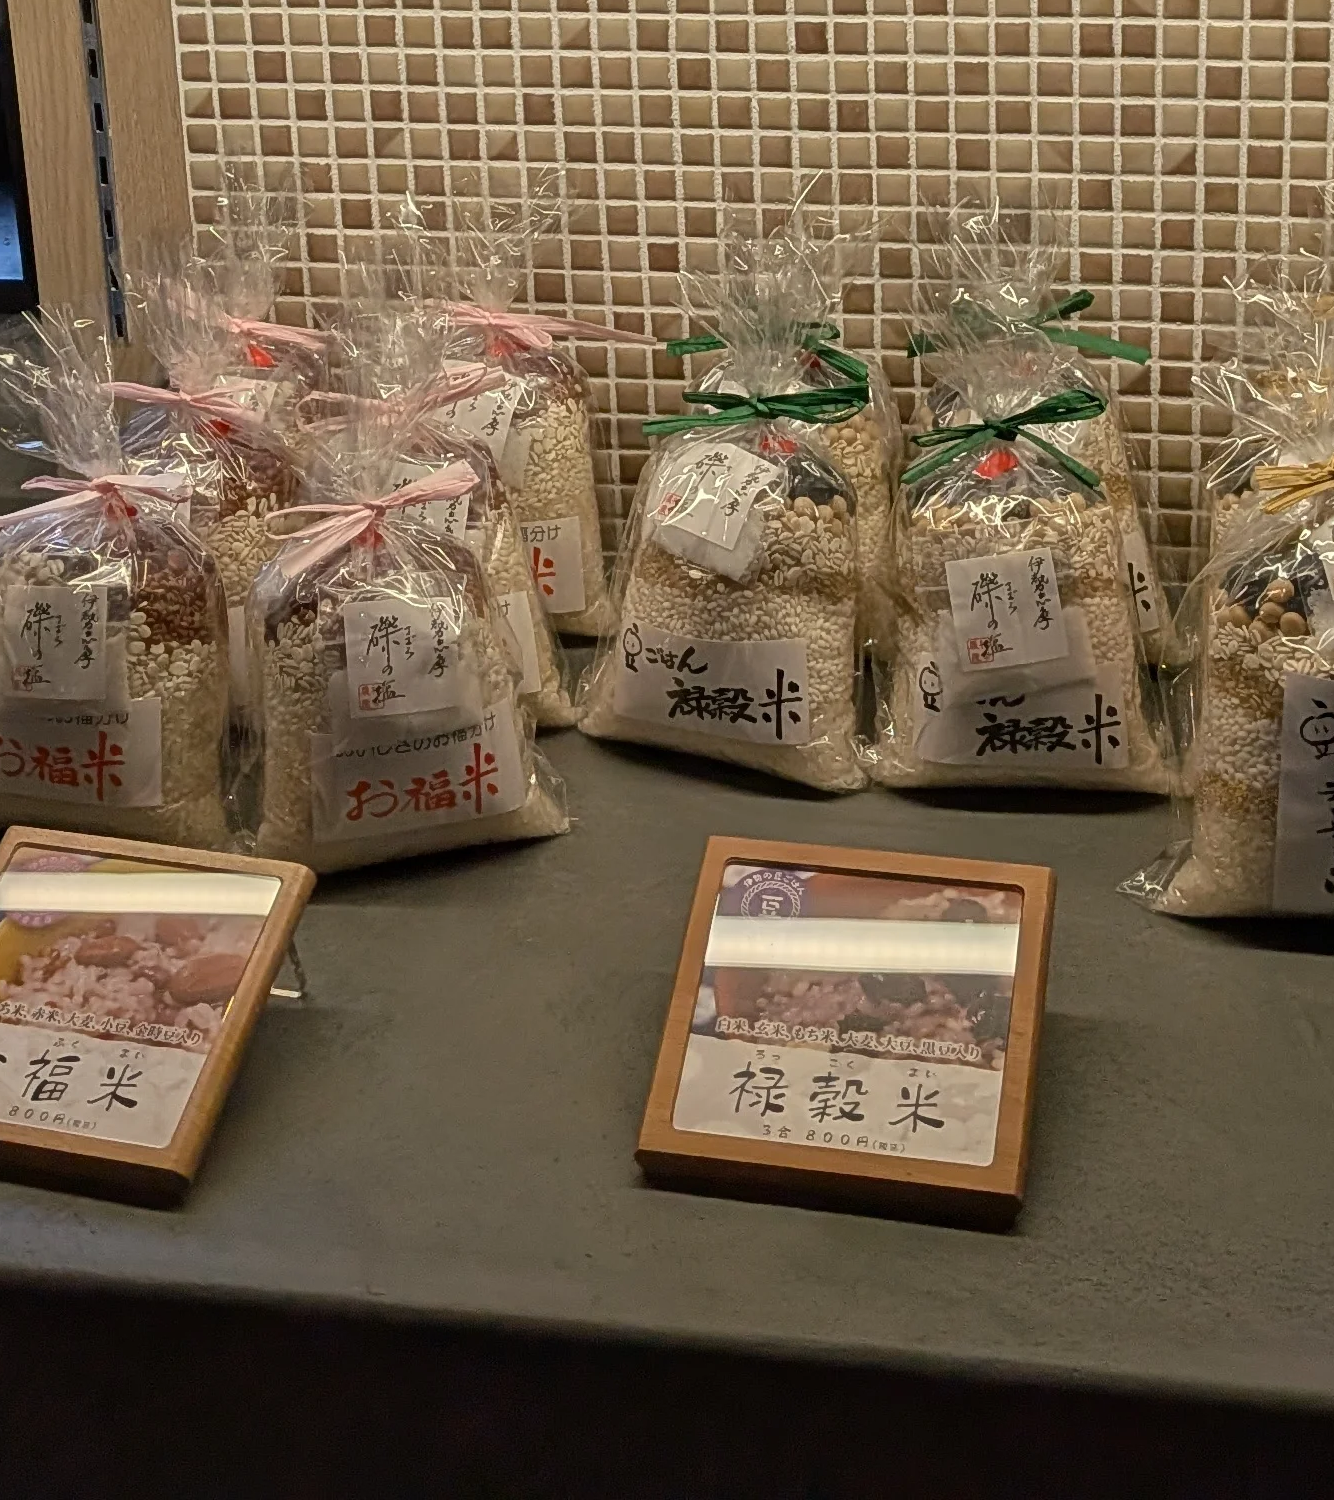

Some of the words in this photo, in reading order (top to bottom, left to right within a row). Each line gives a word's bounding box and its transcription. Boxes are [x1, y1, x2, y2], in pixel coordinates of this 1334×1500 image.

[667, 668, 802, 740] 禄穀米
[976, 693, 1122, 765] 禄穀米
[346, 742, 499, 821] お福米
[715, 1016, 983, 1062] 白米、玄米、もち米、大麦、大豆、黒豆入り
[729, 1060, 945, 1133] 禄穀米
